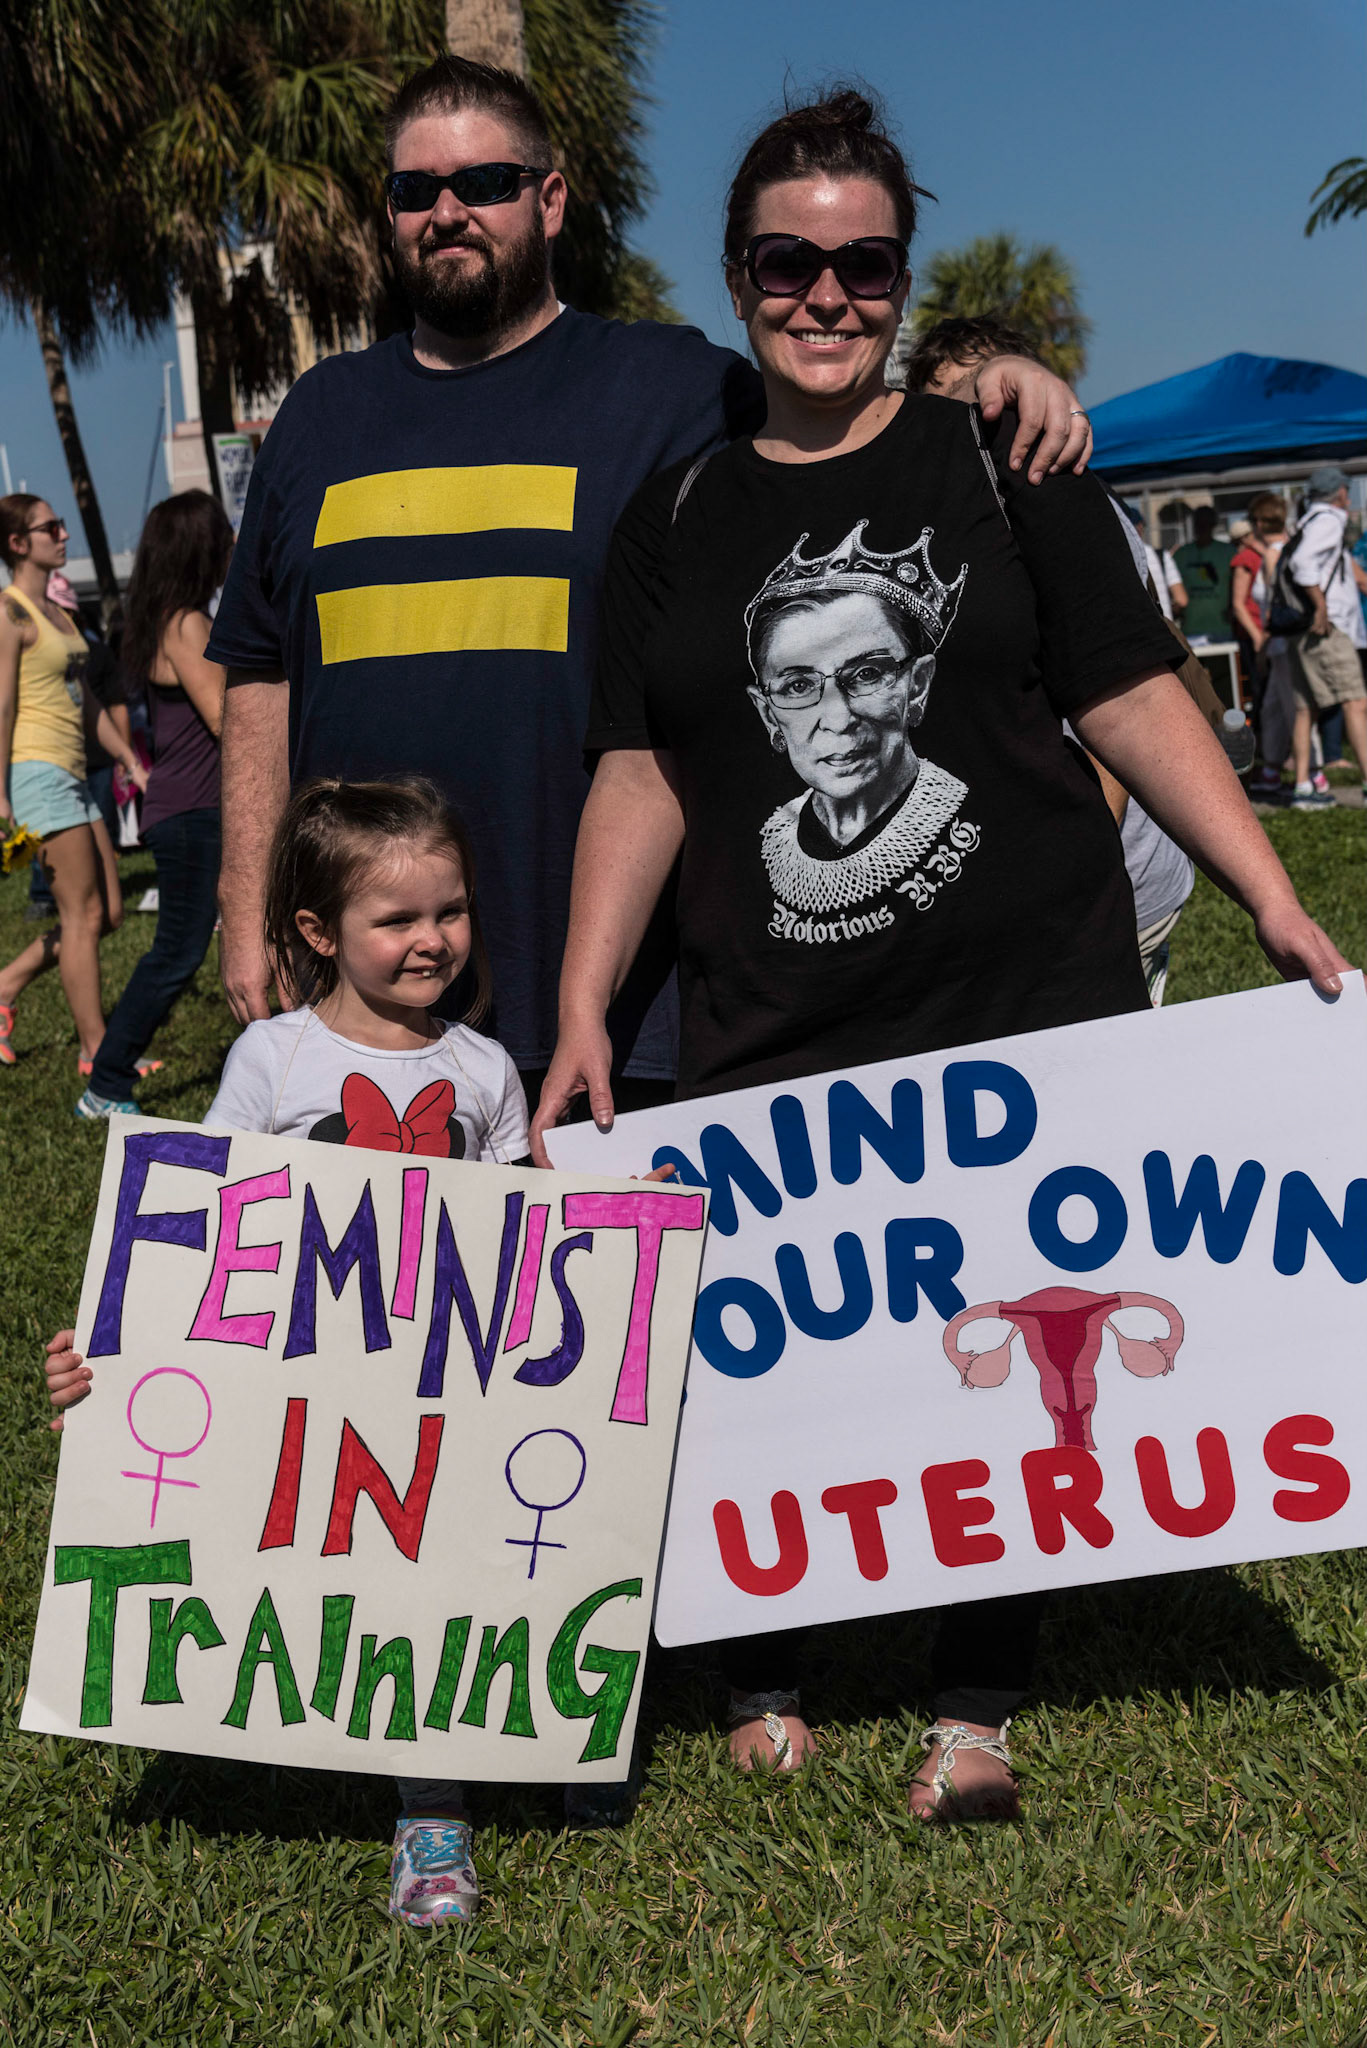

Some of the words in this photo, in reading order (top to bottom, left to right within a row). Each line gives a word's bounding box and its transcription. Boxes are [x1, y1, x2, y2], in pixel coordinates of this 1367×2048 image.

[768, 899, 895, 944] Notorious
[652, 1060, 1038, 1237] MIND
[86, 1132, 704, 1426] FEMINIST
[681, 1217, 967, 1408] OUR
[1028, 1149, 1367, 1284] OWN
[257, 1397, 446, 1563] IN
[712, 1414, 1351, 1596] UTERUS
